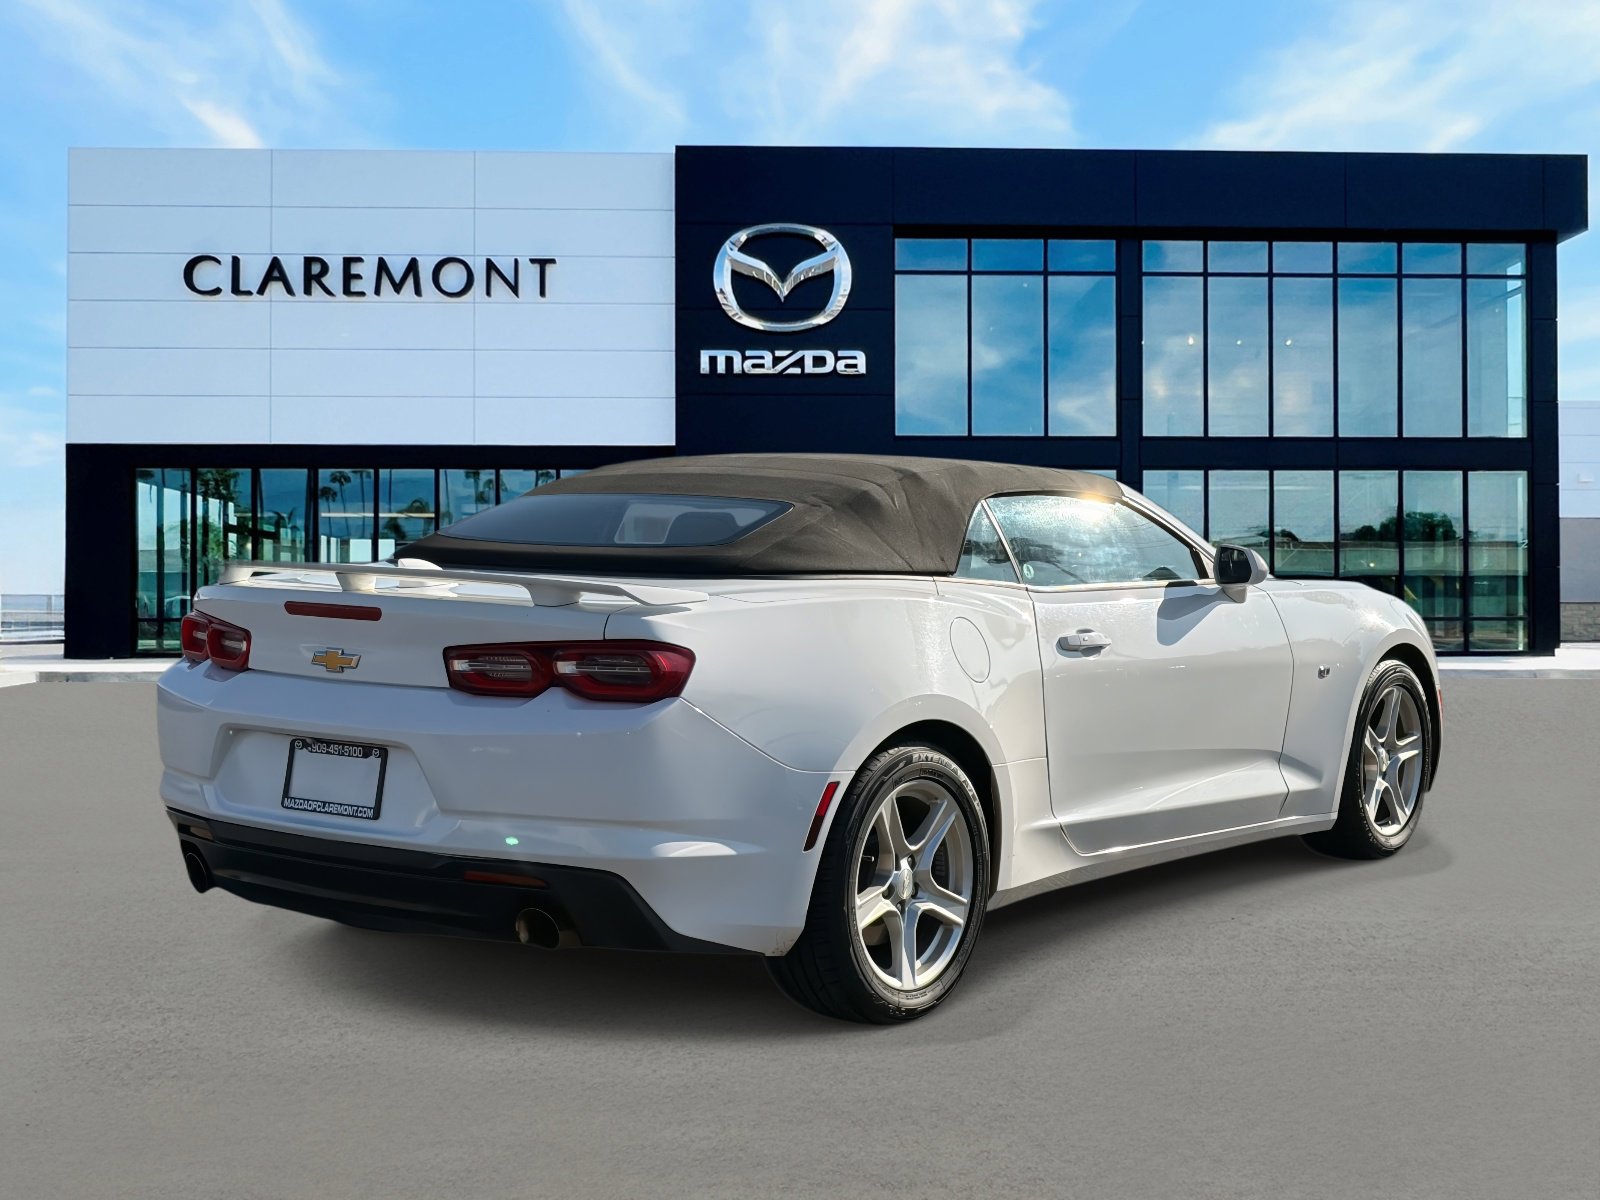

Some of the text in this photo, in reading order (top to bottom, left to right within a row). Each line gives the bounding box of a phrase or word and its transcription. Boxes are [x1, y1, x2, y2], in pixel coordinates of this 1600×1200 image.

[183, 254, 557, 299] CLAREMONT
[311, 743, 363, 757] 909-451-5100
[283, 797, 374, 819] MAZDAOFCLAREMONT.COM
